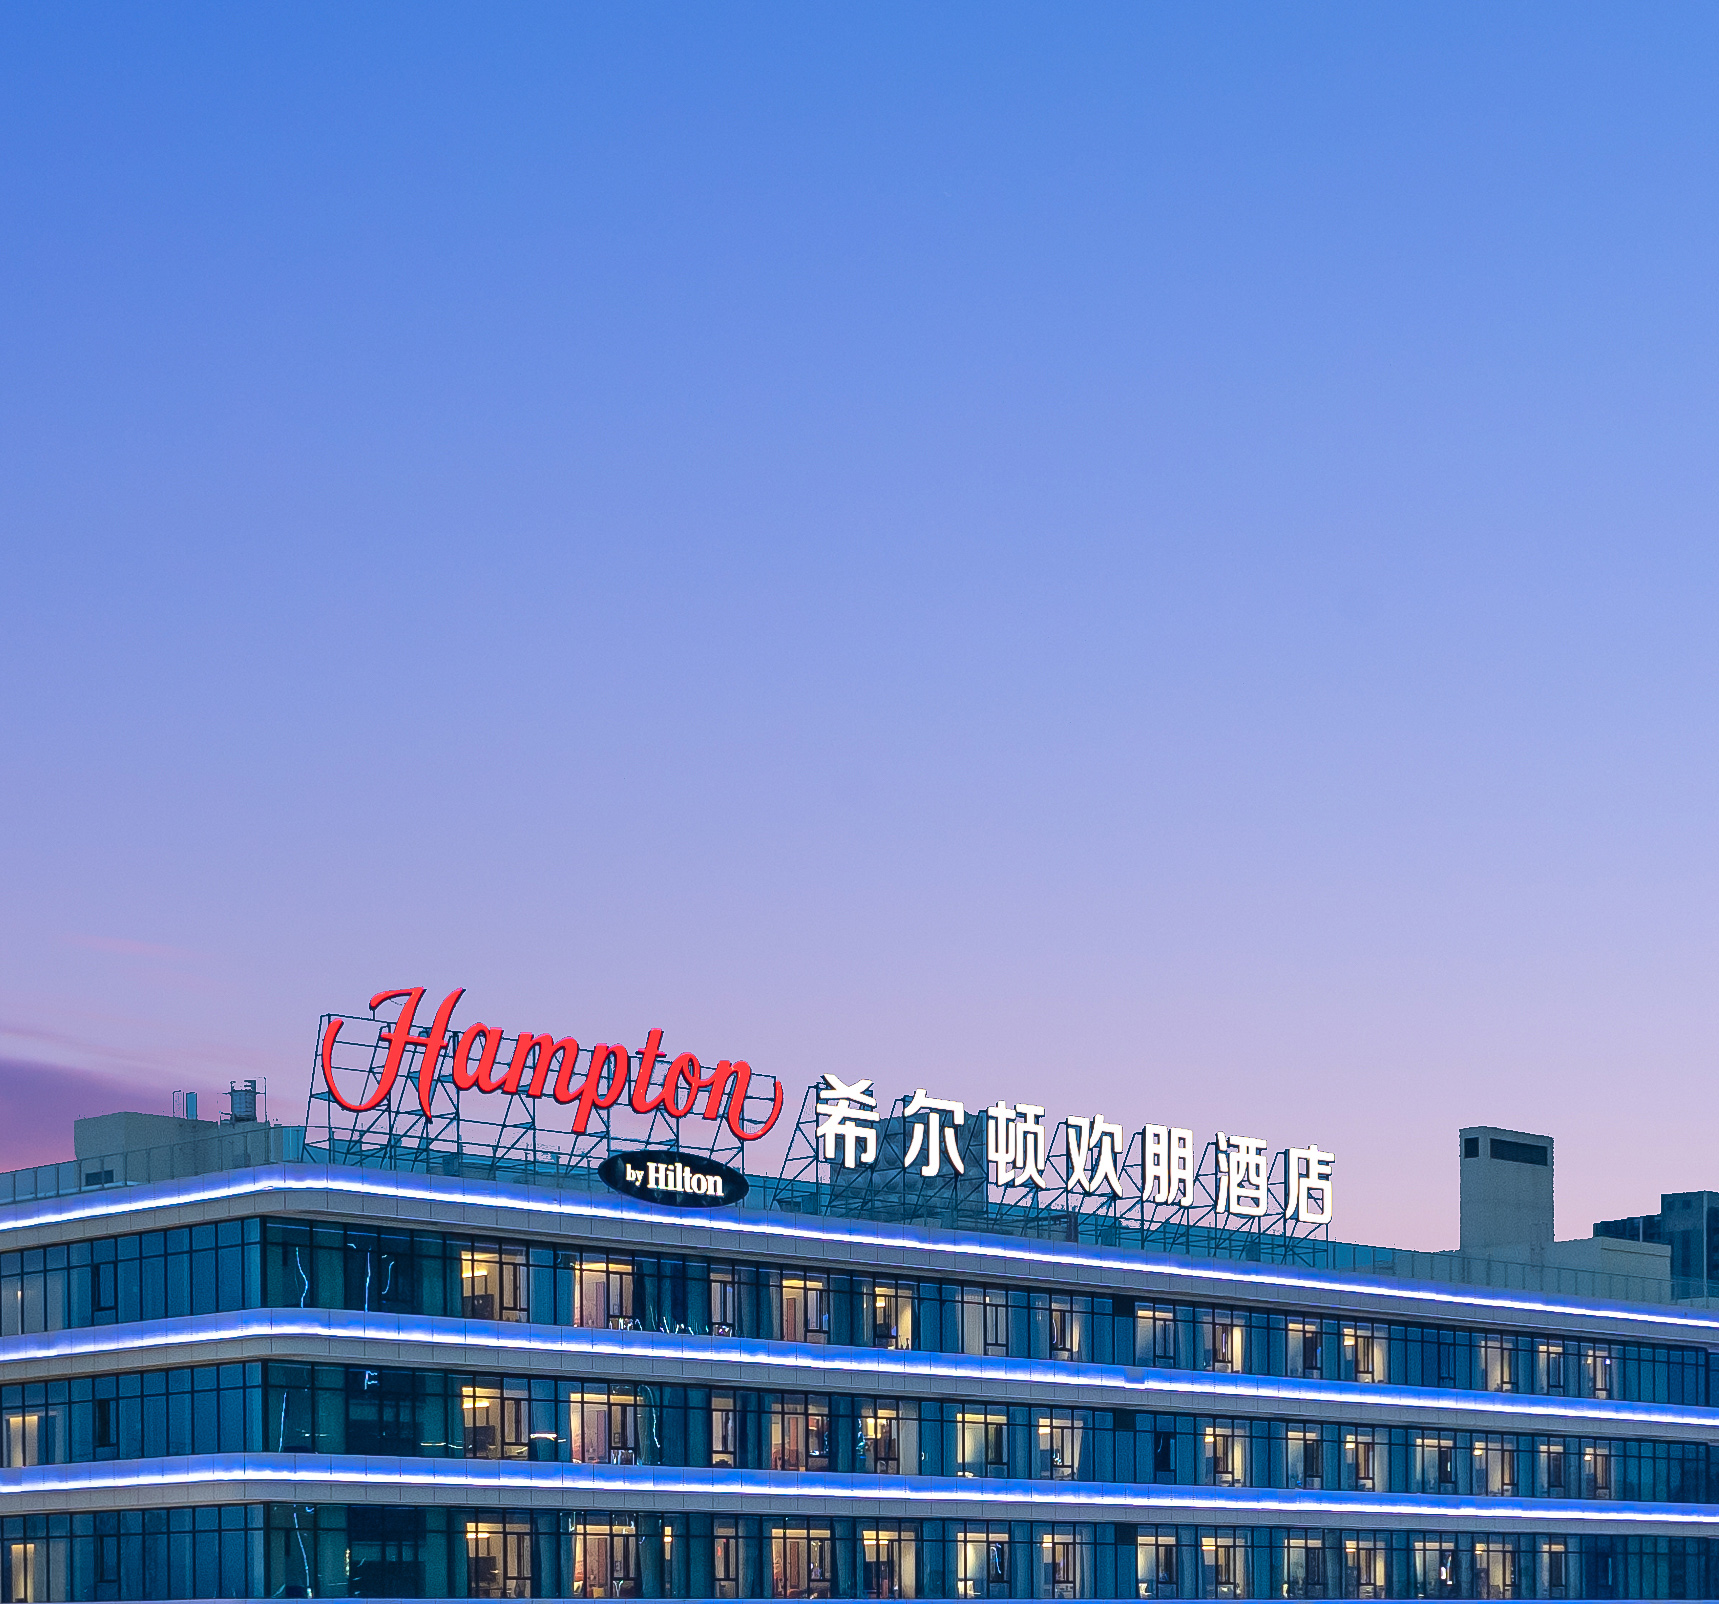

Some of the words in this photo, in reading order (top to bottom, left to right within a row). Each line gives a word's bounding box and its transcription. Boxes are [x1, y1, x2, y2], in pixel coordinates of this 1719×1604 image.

[323, 986, 783, 1140] Hampton
[626, 1164, 644, 1186] by
[646, 1162, 725, 1196] Hilton
[816, 1073, 1335, 1224] 希尔顿欢朋酒店
